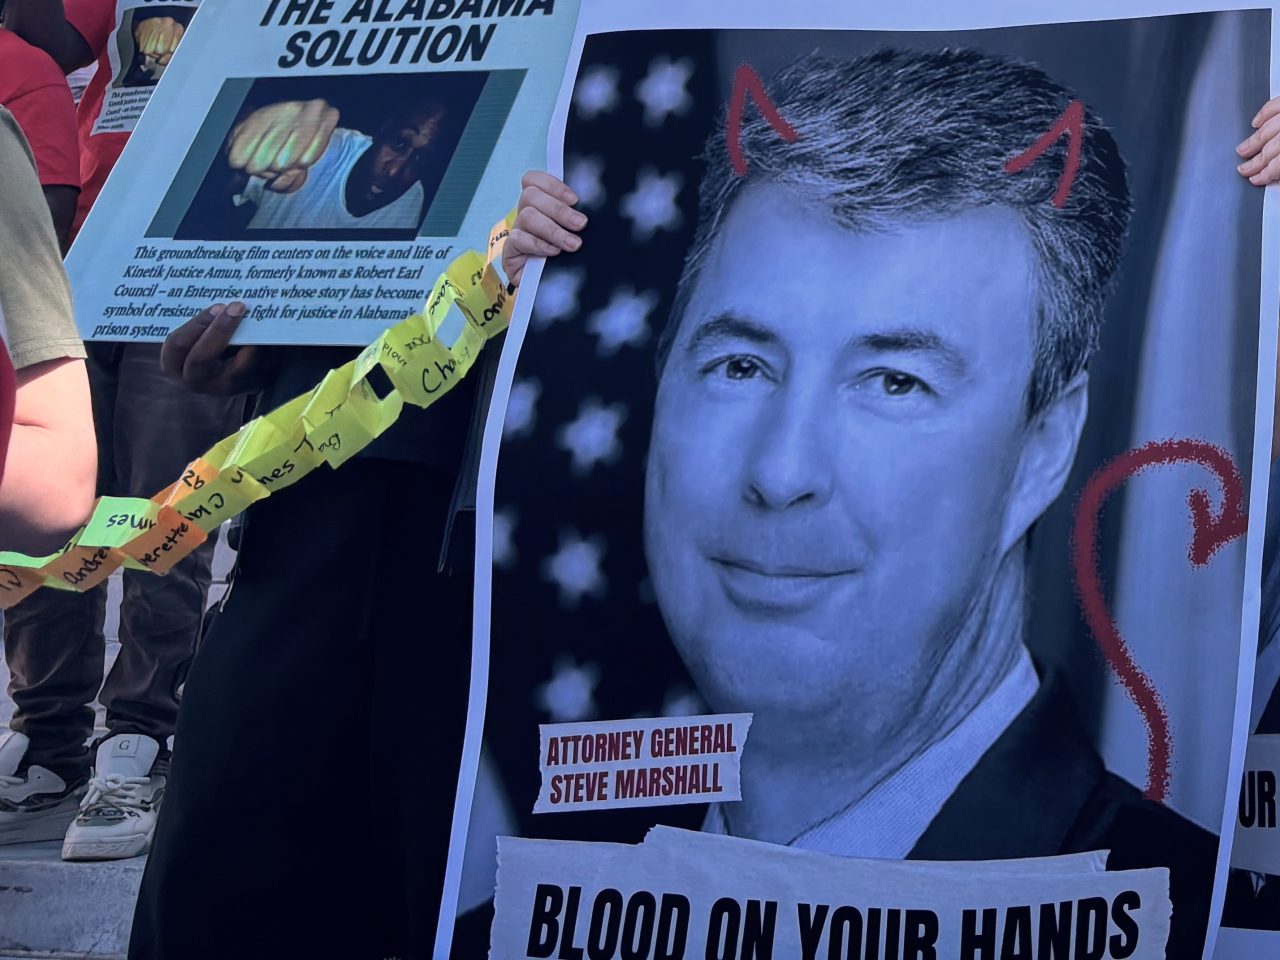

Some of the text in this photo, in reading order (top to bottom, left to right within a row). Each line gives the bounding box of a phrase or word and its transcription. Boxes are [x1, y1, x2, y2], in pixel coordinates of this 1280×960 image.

[278, 24, 498, 69] SOLUTION
[133, 245, 453, 262] This groundbreaking film centers on the voice and life of
[122, 265, 424, 281] Kinetik Justice Amun, formerly known as Robert Earl
[114, 283, 159, 297] Council
[167, 287, 182, 297] an
[184, 285, 242, 300] Enterprise
[242, 285, 278, 298] native
[280, 285, 316, 298] whose
[317, 286, 348, 301] story
[350, 285, 372, 298] has
[374, 285, 424, 299] become
[103, 304, 149, 318] symbol
[144, 304, 162, 316] of
[251, 305, 278, 320] fight
[279, 305, 299, 320] for
[296, 305, 340, 321] justice
[341, 306, 352, 319] in
[93, 324, 129, 338] prison
[546, 723, 737, 767] ATTORNEY GENERAL
[550, 763, 723, 804] STEVE MARSHALL
[526, 883, 1141, 960] BLOOD ON YOUR HANDS
